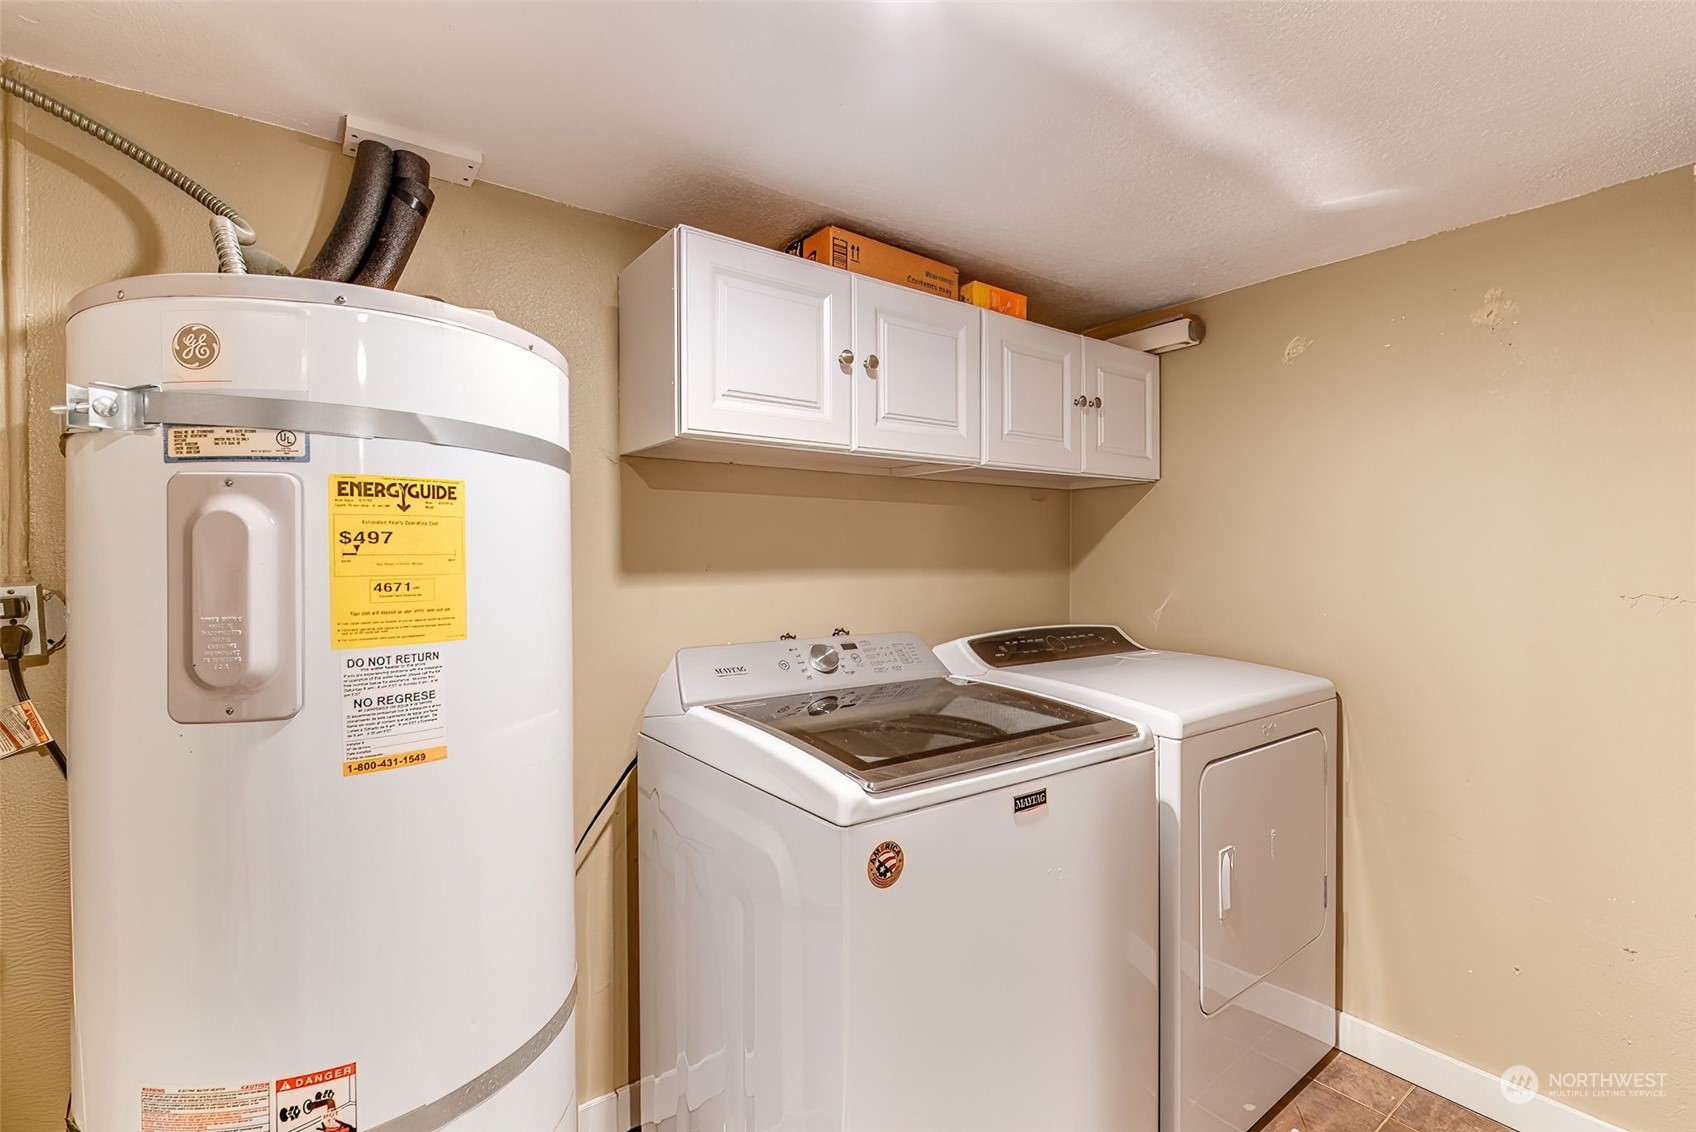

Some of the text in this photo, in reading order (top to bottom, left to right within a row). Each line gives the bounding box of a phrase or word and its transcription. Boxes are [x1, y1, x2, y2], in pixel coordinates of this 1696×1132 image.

[280, 432, 292, 444] UL
[339, 531, 393, 544] $497
[374, 582, 411, 592] 4671
[348, 652, 439, 668] DO NOT RETURN
[714, 666, 747, 674] MAYTAG
[354, 698, 372, 708] NO
[378, 690, 436, 706] REGRESE
[348, 753, 426, 773] 1-800-431-1549
[1016, 793, 1046, 809] MAYTAG
[296, 1066, 351, 1087] DANGER
